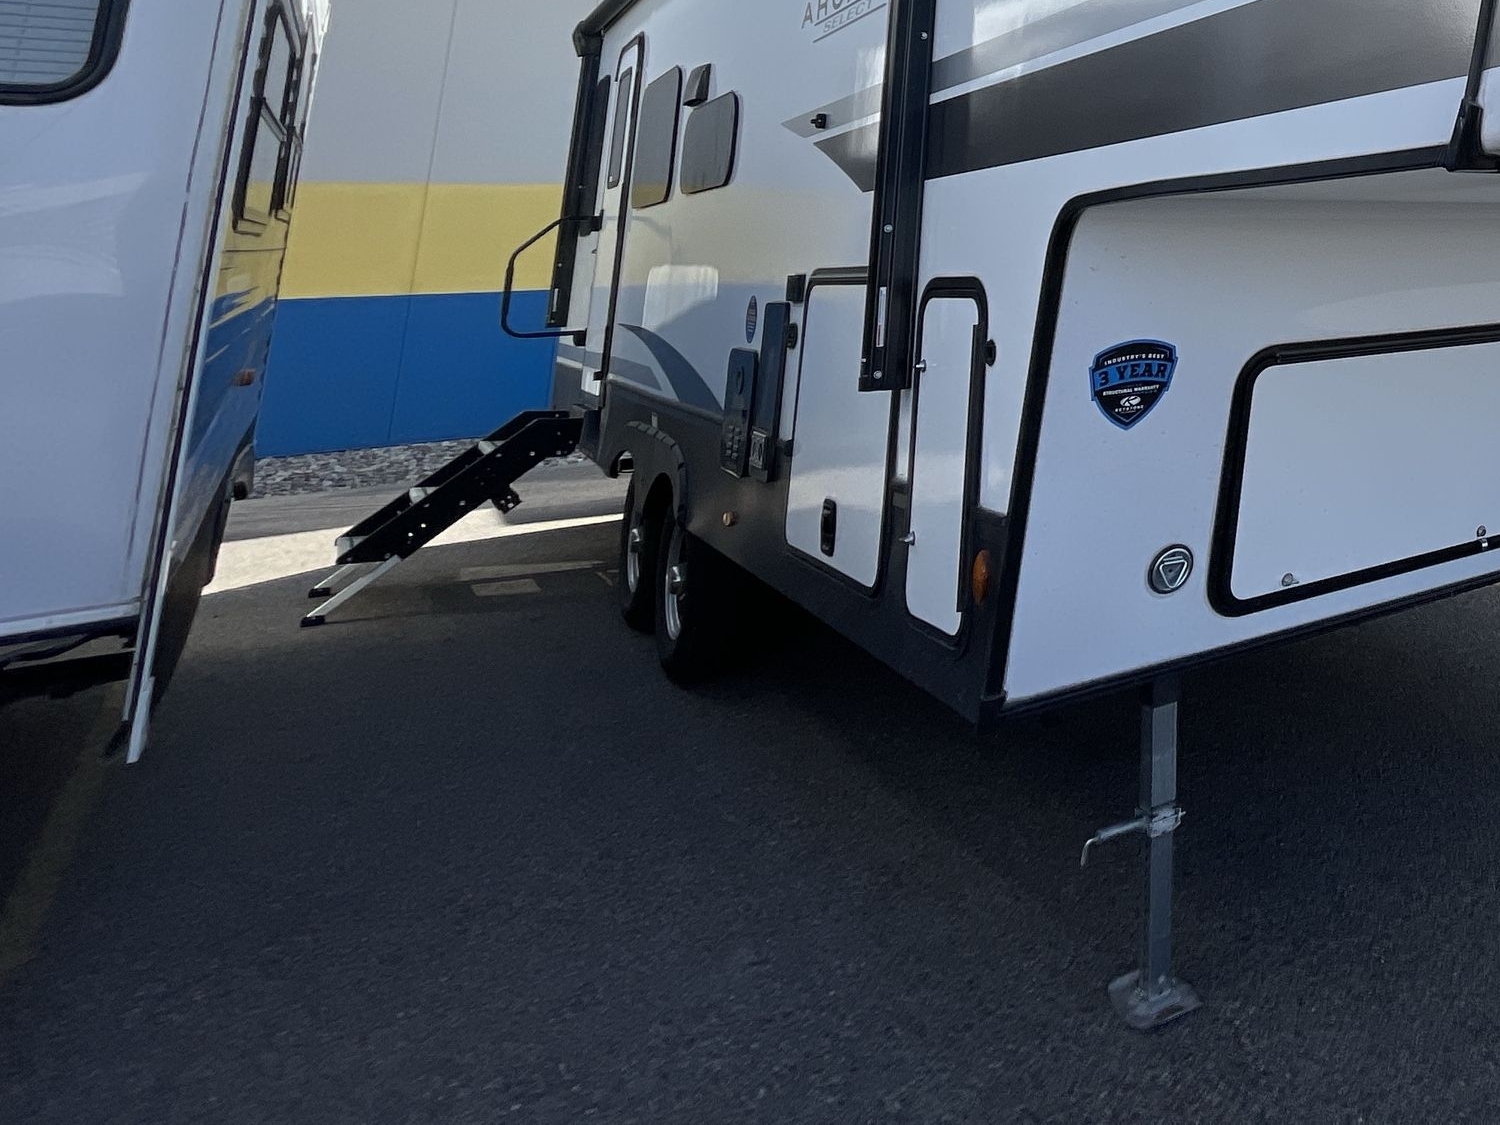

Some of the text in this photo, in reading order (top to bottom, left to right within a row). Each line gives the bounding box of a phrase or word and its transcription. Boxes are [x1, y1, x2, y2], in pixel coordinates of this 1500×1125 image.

[1104, 354, 1146, 366] INDUSTRY'S
[1098, 362, 1168, 387] 3 YEAR
